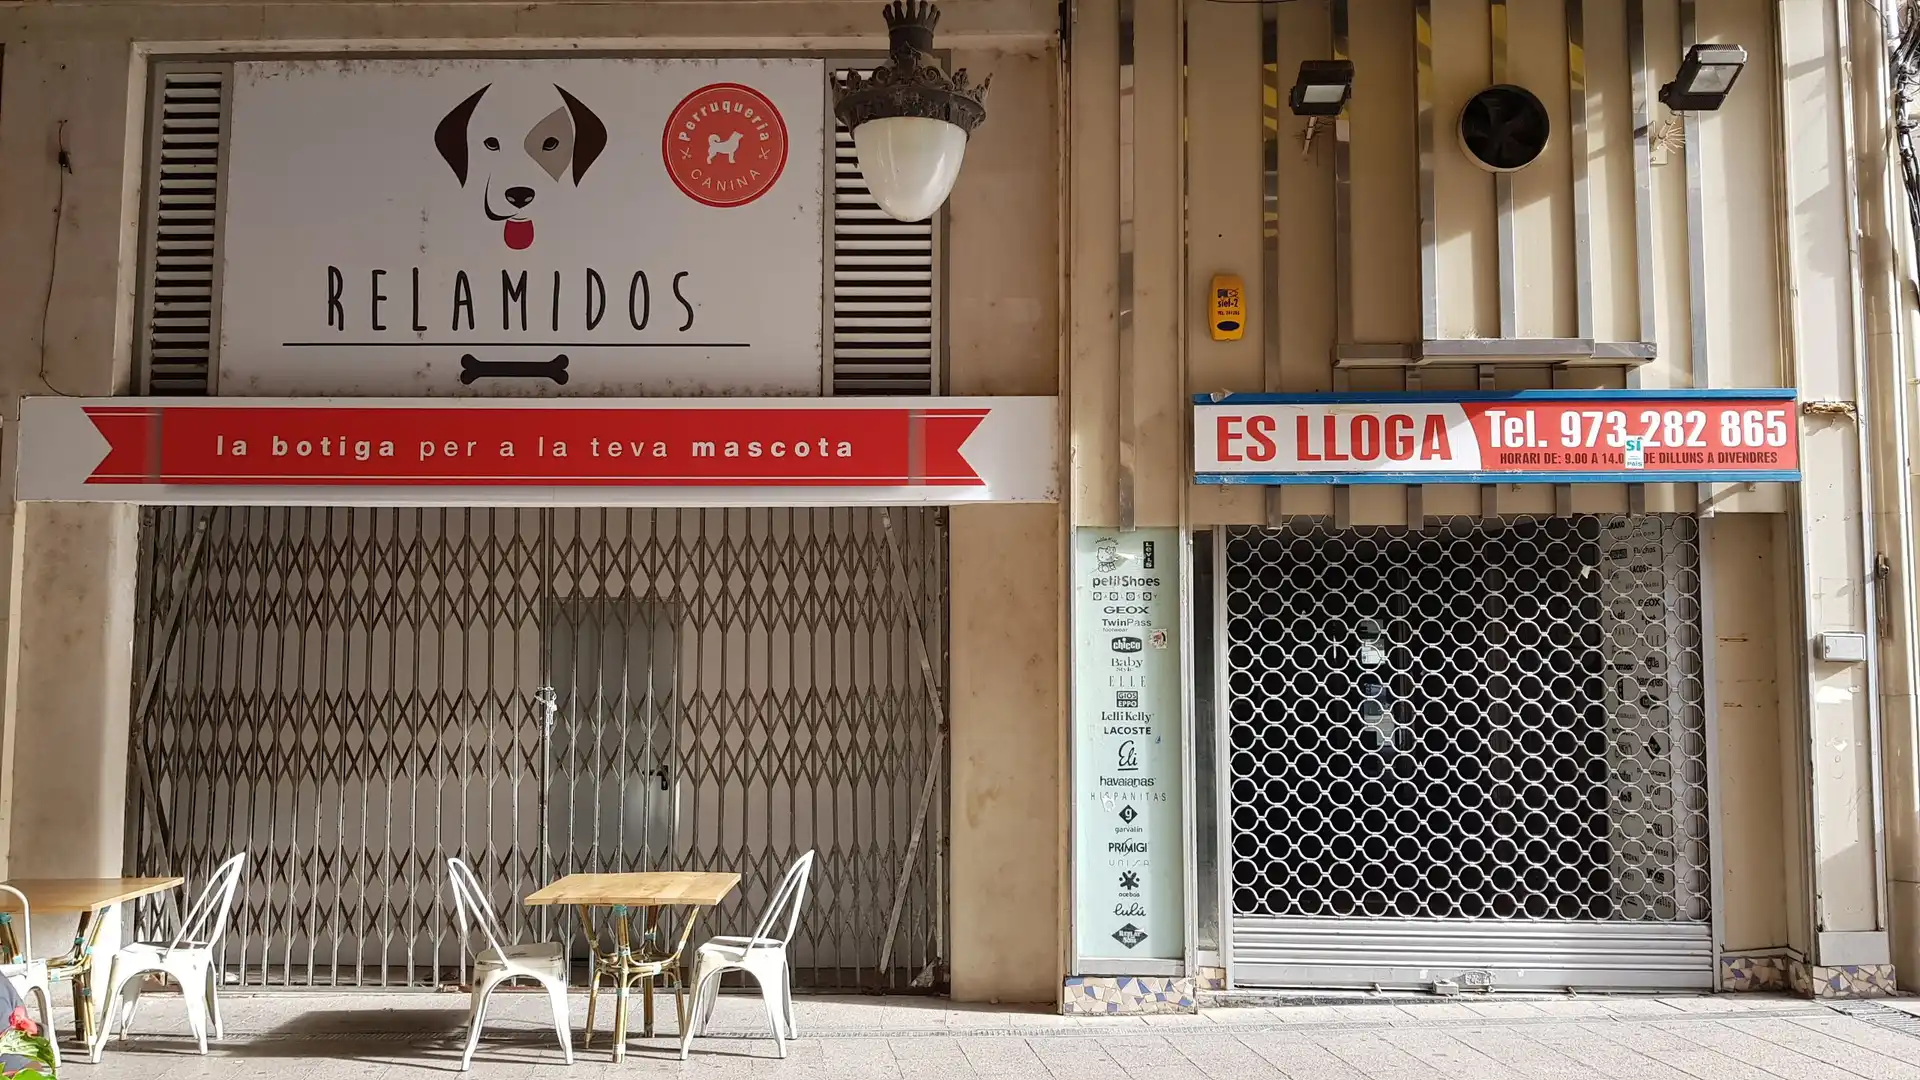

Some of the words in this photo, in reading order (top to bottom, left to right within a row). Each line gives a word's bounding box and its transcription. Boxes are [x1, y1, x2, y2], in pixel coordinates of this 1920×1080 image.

[678, 100, 770, 142] Perruqueria
[691, 168, 761, 192] CANINA
[328, 265, 694, 332] RELAMIDOS
[1484, 410, 1548, 448] Tel.
[1560, 410, 1627, 448] 973
[1640, 410, 1707, 448] 282
[1720, 410, 1788, 447] 865
[1216, 415, 1277, 462] ES
[1296, 414, 1453, 462] LLOGA
[217, 435, 247, 457] la
[272, 435, 394, 461] botiga
[419, 441, 477, 462] per
[499, 441, 515, 457] a
[538, 436, 568, 457] la
[590, 437, 668, 458] teva
[692, 437, 852, 458] mascota
[1500, 452, 1541, 465] HORARI
[1543, 452, 1562, 465] DE:
[1564, 452, 1588, 465] 9.00
[1591, 453, 1599, 465] A
[1602, 452, 1625, 465] 14.0
[1658, 451, 1705, 464] DILLUNS
[1707, 452, 1715, 464] A
[1717, 451, 1778, 464] DIVENDRES
[1103, 606, 1150, 614] GEOX
[1102, 618, 1152, 627] TwinPass
[1112, 637, 1141, 650] chicco
[1112, 656, 1143, 668] Baby
[1109, 675, 1146, 687] ELLE
[1103, 727, 1152, 735] LACOSTE
[1100, 776, 1154, 788] havaianas
[1108, 841, 1148, 853] PRIMIGI
